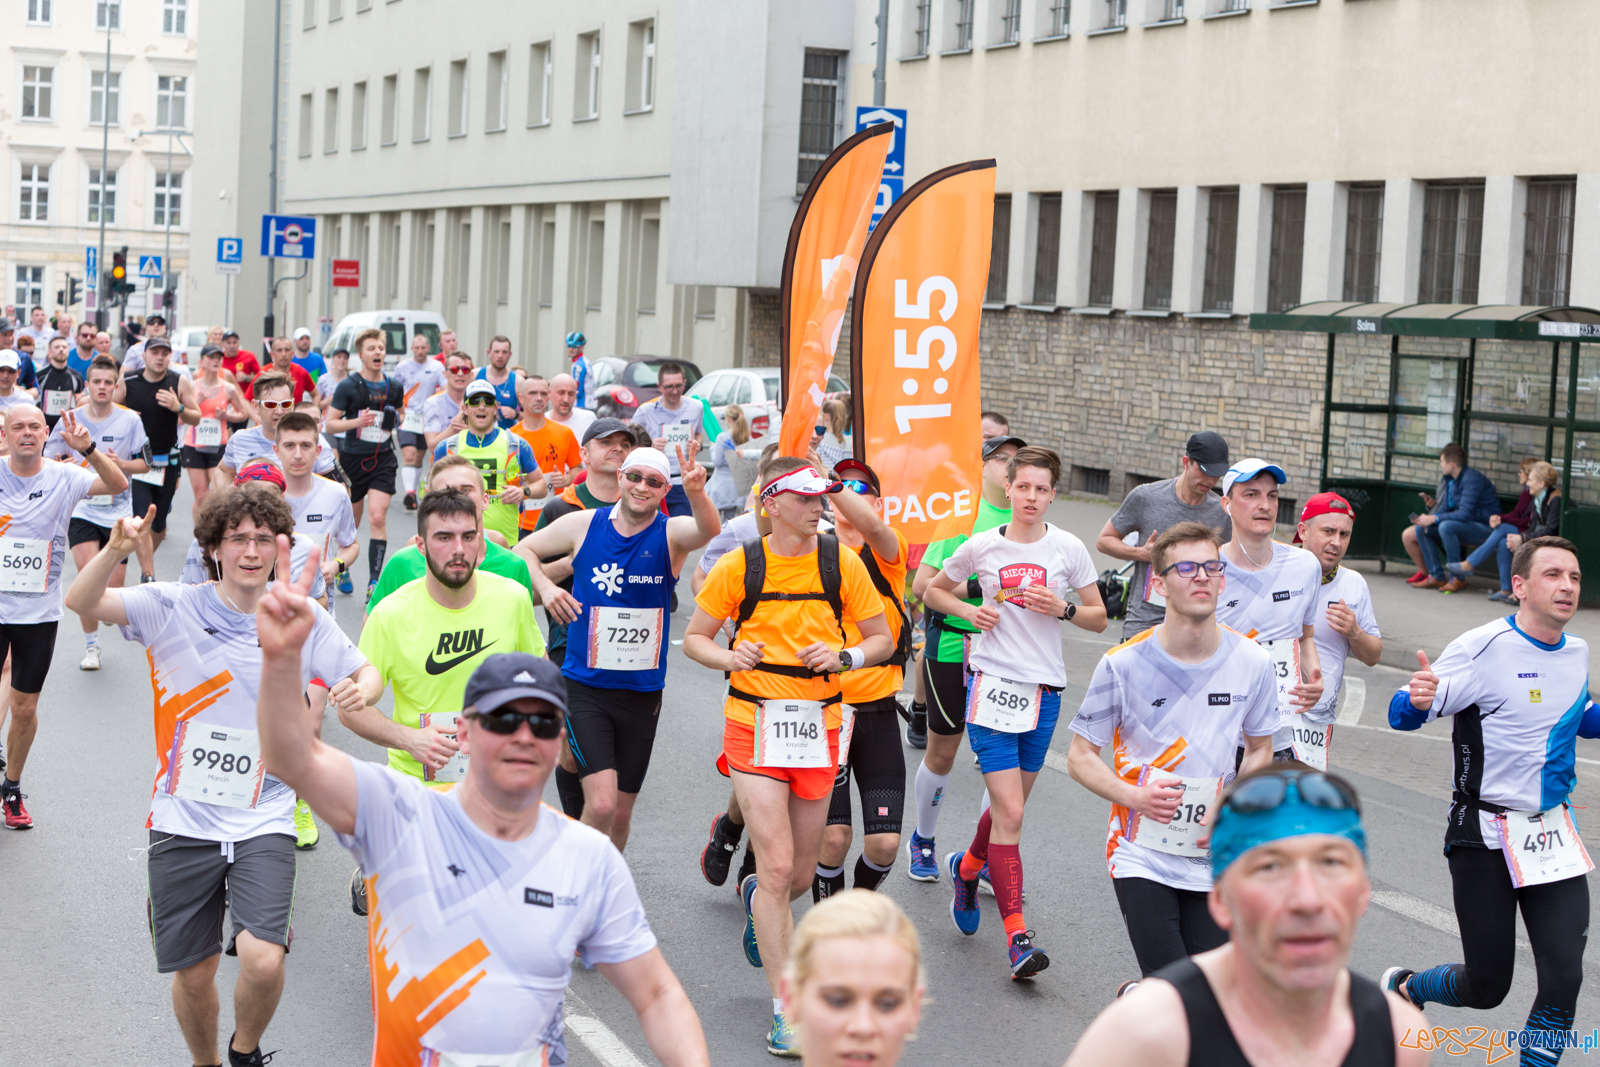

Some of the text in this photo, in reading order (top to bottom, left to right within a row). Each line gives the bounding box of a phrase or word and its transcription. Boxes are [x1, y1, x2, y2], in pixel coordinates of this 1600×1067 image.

[222, 239, 238, 260] P
[1356, 319, 1376, 332] Solna
[894, 275, 958, 435] 1:55
[199, 426, 219, 434] 6988
[667, 434, 689, 443] 2099
[883, 489, 971, 525] PACE
[2, 555, 42, 570] 5690
[628, 575, 664, 584] GRUPA GT
[1002, 568, 1044, 579] BIEGAM
[1226, 599, 1239, 608] 4F
[436, 628, 484, 655] RUN
[607, 627, 650, 644] 7229
[986, 688, 1029, 711] 4589
[1151, 698, 1167, 708] 4F
[773, 721, 818, 739] 11148
[192, 747, 252, 775] 9980
[207, 774, 230, 783] Marcin
[1167, 824, 1188, 834] Albert
[1523, 829, 1564, 853] 4971
[1004, 856, 1019, 910] Kalenji
